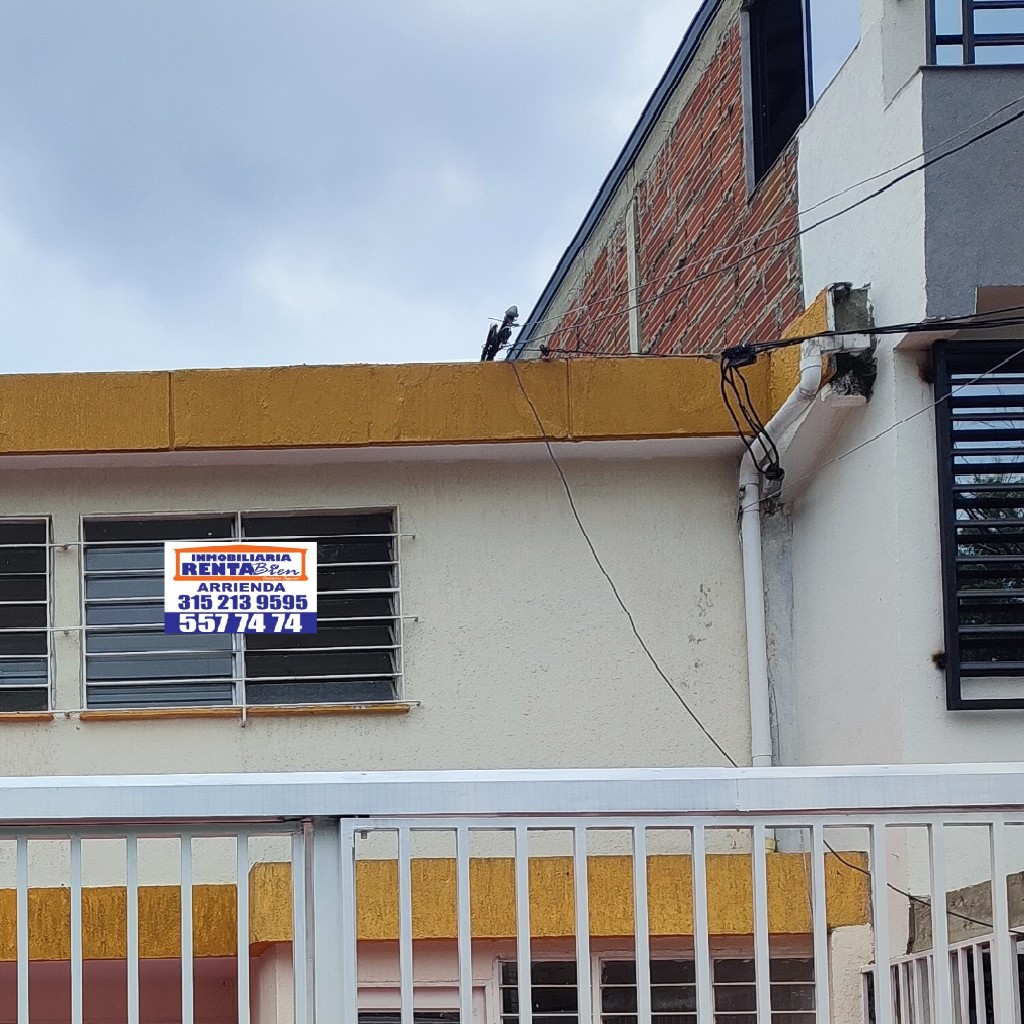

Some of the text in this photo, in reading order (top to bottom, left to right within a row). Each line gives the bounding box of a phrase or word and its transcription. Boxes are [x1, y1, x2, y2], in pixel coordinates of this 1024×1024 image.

[191, 554, 292, 562] INMOBILIARIA
[197, 582, 286, 593] ARRIENDA
[178, 594, 308, 610] 315 213 9595
[179, 613, 303, 633] 557 74 74
